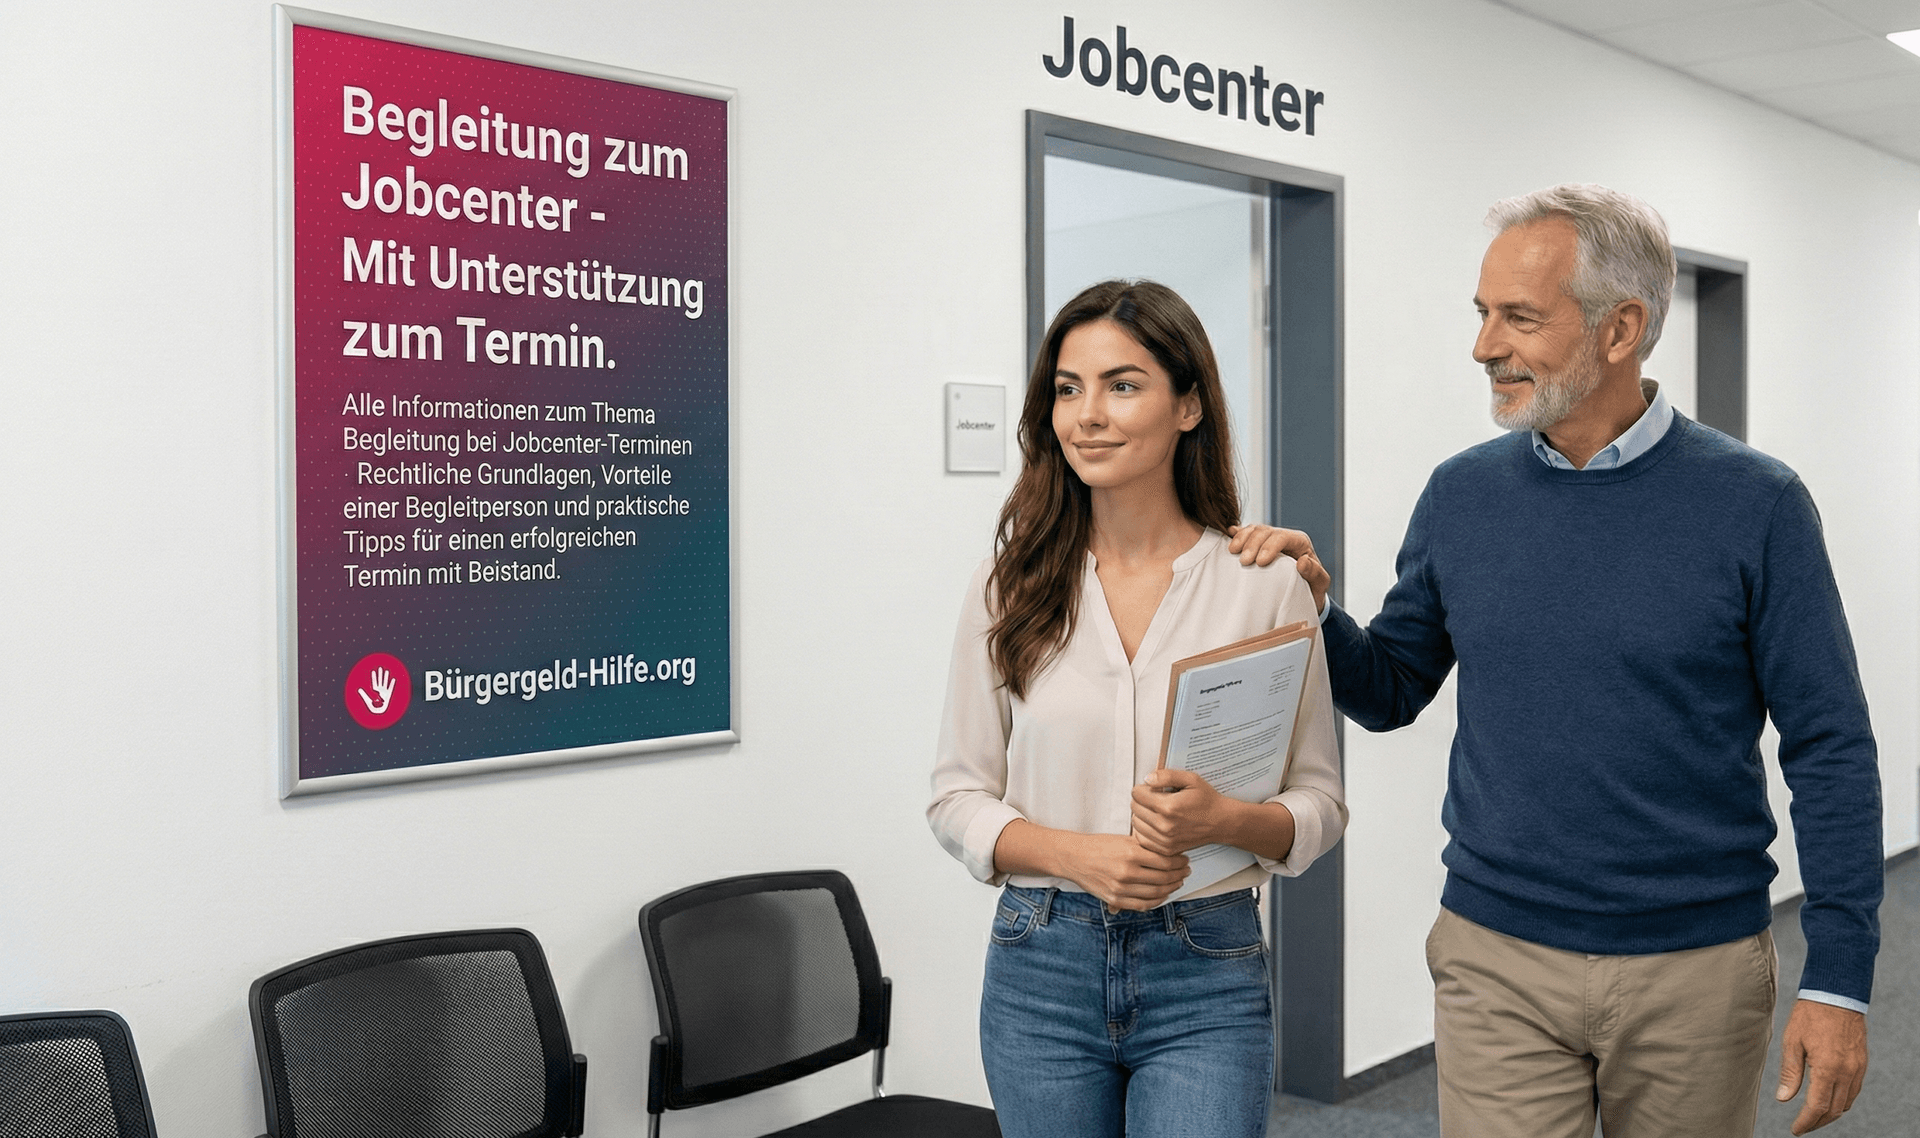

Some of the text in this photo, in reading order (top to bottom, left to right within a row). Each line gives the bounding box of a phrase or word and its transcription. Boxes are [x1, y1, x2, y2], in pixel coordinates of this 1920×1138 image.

[1043, 16, 1324, 136] Jobcenter
[343, 85, 689, 180] Begleitung zum
[341, 162, 606, 232] Jobcenter -
[342, 236, 705, 319] Mit Unterstützung
[342, 316, 616, 370] zum Termin.
[342, 393, 656, 424] Alle Informationen zum Thema
[956, 418, 996, 430] Jobcenter
[344, 427, 692, 456] Begleitung bei Jobcenter-Terminen
[358, 462, 672, 490] Rechtliche Grundlagen, Vorteile
[343, 495, 690, 523] einer Begleitperson und praktische
[343, 527, 637, 558] Tipps für einen erfolgreichen
[344, 558, 561, 587] Termin mit Beistand.
[424, 654, 696, 705] Bürgergeld-Hilfe.org
